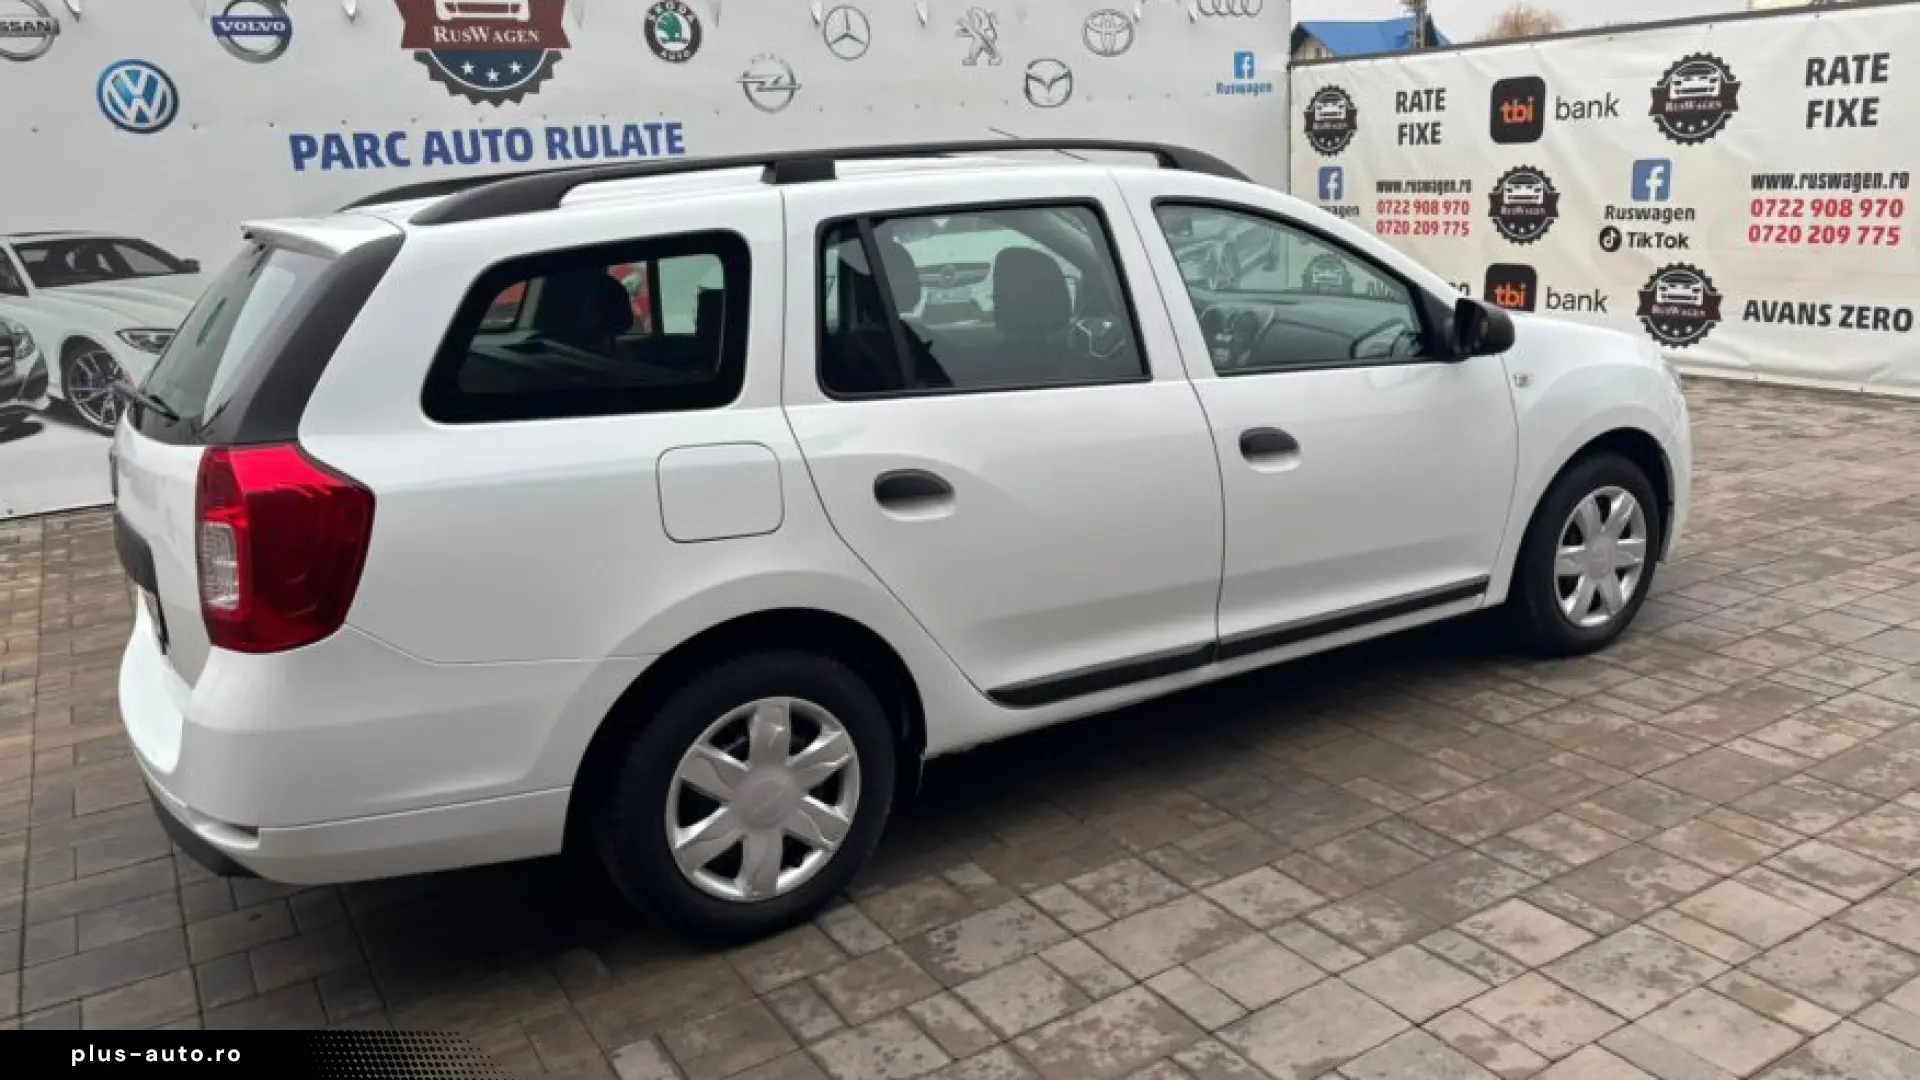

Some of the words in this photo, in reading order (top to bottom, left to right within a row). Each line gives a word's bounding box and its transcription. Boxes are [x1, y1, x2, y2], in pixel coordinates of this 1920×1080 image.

[217, 21, 286, 32] VOLVO
[1805, 52, 1891, 87] RATE
[1395, 87, 1447, 114] RATE
[1500, 96, 1535, 124] tbi
[1555, 91, 1621, 121] bank
[1805, 96, 1880, 130] FIXE
[1397, 121, 1443, 146] FIXE
[289, 131, 411, 171] PARC
[422, 127, 534, 165] AUTO
[545, 121, 686, 160] RULATE
[1750, 172, 1910, 194] www.ruswagen.ro
[1375, 199, 1410, 215] 0722
[1413, 199, 1439, 215] 908
[1442, 198, 1471, 215] 970
[1604, 205, 1696, 224] Ruswagen
[1750, 198, 1805, 218] 0722
[1810, 198, 1853, 218] 908
[1860, 198, 1904, 218] 970
[1375, 220, 1410, 236] 0720
[1413, 220, 1439, 236] 209
[1442, 220, 1470, 237] 775
[1626, 231, 1689, 249] TikTok
[1748, 225, 1802, 244] 0720
[1807, 225, 1850, 245] 209
[1858, 225, 1901, 246] 775
[1493, 282, 1527, 308] tbi
[1546, 285, 1611, 313] bank
[1742, 299, 1833, 327] AVANS
[1838, 304, 1914, 333] ZERO
